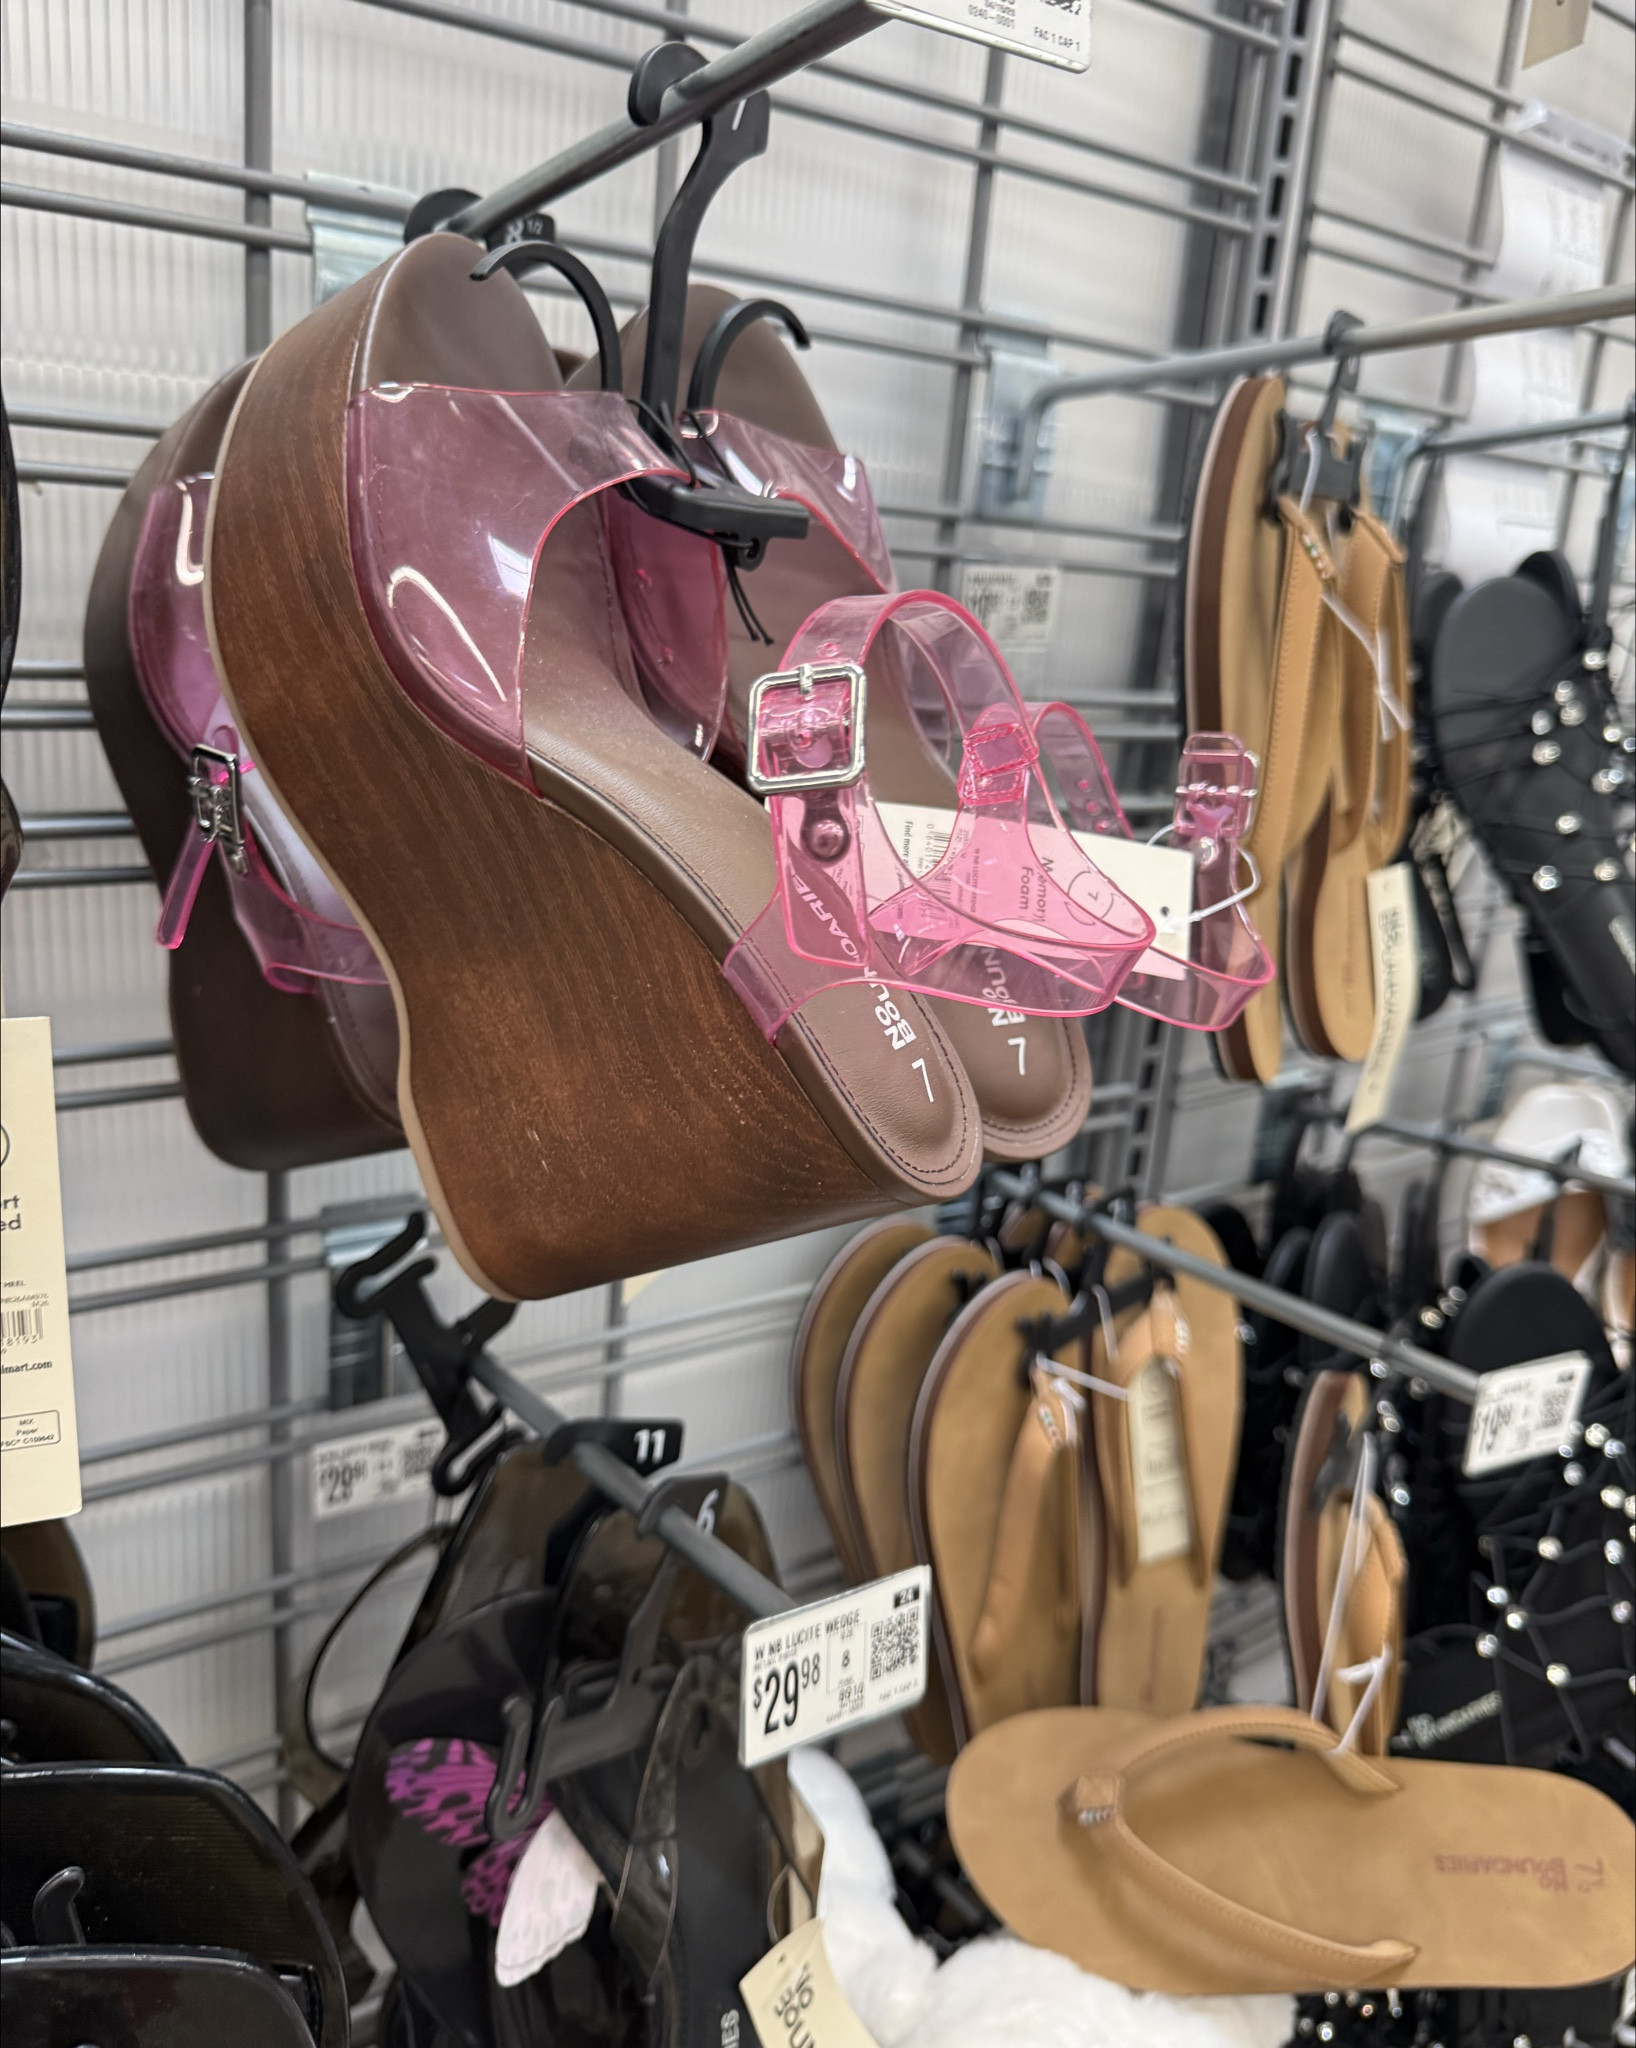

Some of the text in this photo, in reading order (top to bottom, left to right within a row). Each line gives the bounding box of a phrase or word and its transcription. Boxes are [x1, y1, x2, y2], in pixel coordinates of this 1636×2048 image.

[902, 838, 911, 857] more
[904, 821, 914, 837] Find
[1018, 866, 1034, 911] Foam
[874, 1005, 907, 1051] NO
[1007, 1037, 1027, 1075] 7
[911, 1057, 934, 1103] 7
[0, 1360, 53, 1374] lmart.com
[633, 1428, 666, 1463] 11
[696, 1488, 719, 1535] 6
[755, 1646, 765, 1661] W
[785, 1623, 822, 1650] LUCITE
[825, 1608, 861, 1634] WEDGE
[842, 1649, 851, 1668] 8
[774, 1985, 815, 2048] BOU
